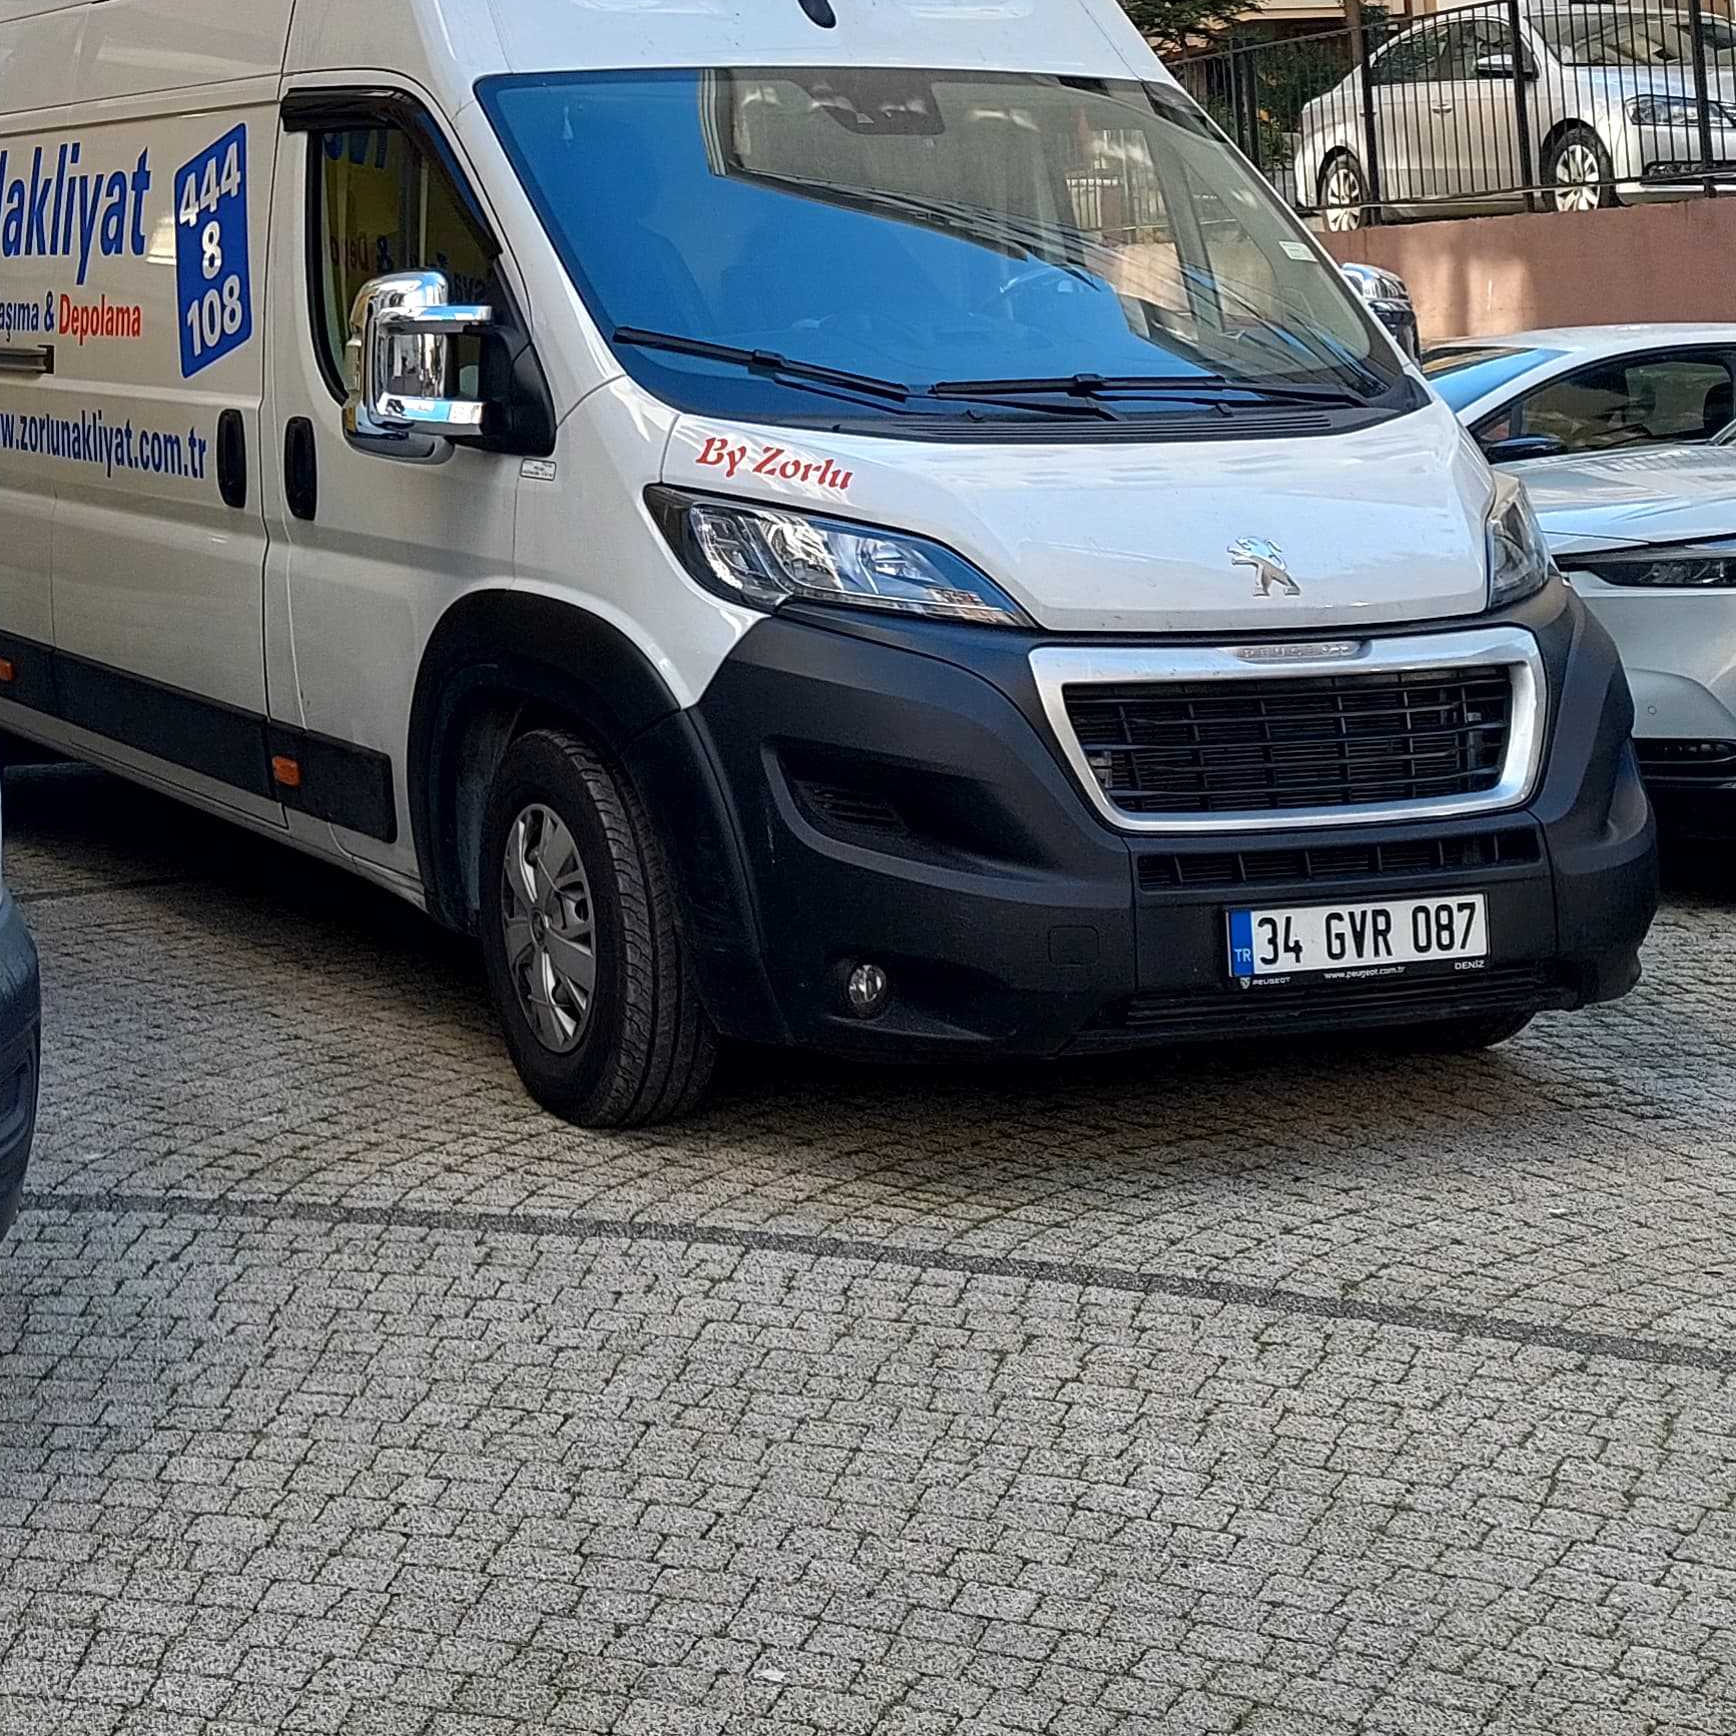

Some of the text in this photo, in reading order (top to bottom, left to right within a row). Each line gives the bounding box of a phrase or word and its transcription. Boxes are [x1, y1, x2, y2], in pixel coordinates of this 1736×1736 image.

[178, 142, 241, 227] 444
[201, 221, 222, 280] 8
[45, 291, 55, 332] &
[59, 294, 141, 345] Depolama
[186, 274, 243, 357] 108
[696, 437, 853, 490] By Zorlu
[1234, 948, 1252, 962] TR
[1257, 902, 1476, 965] 34 GVR 087
